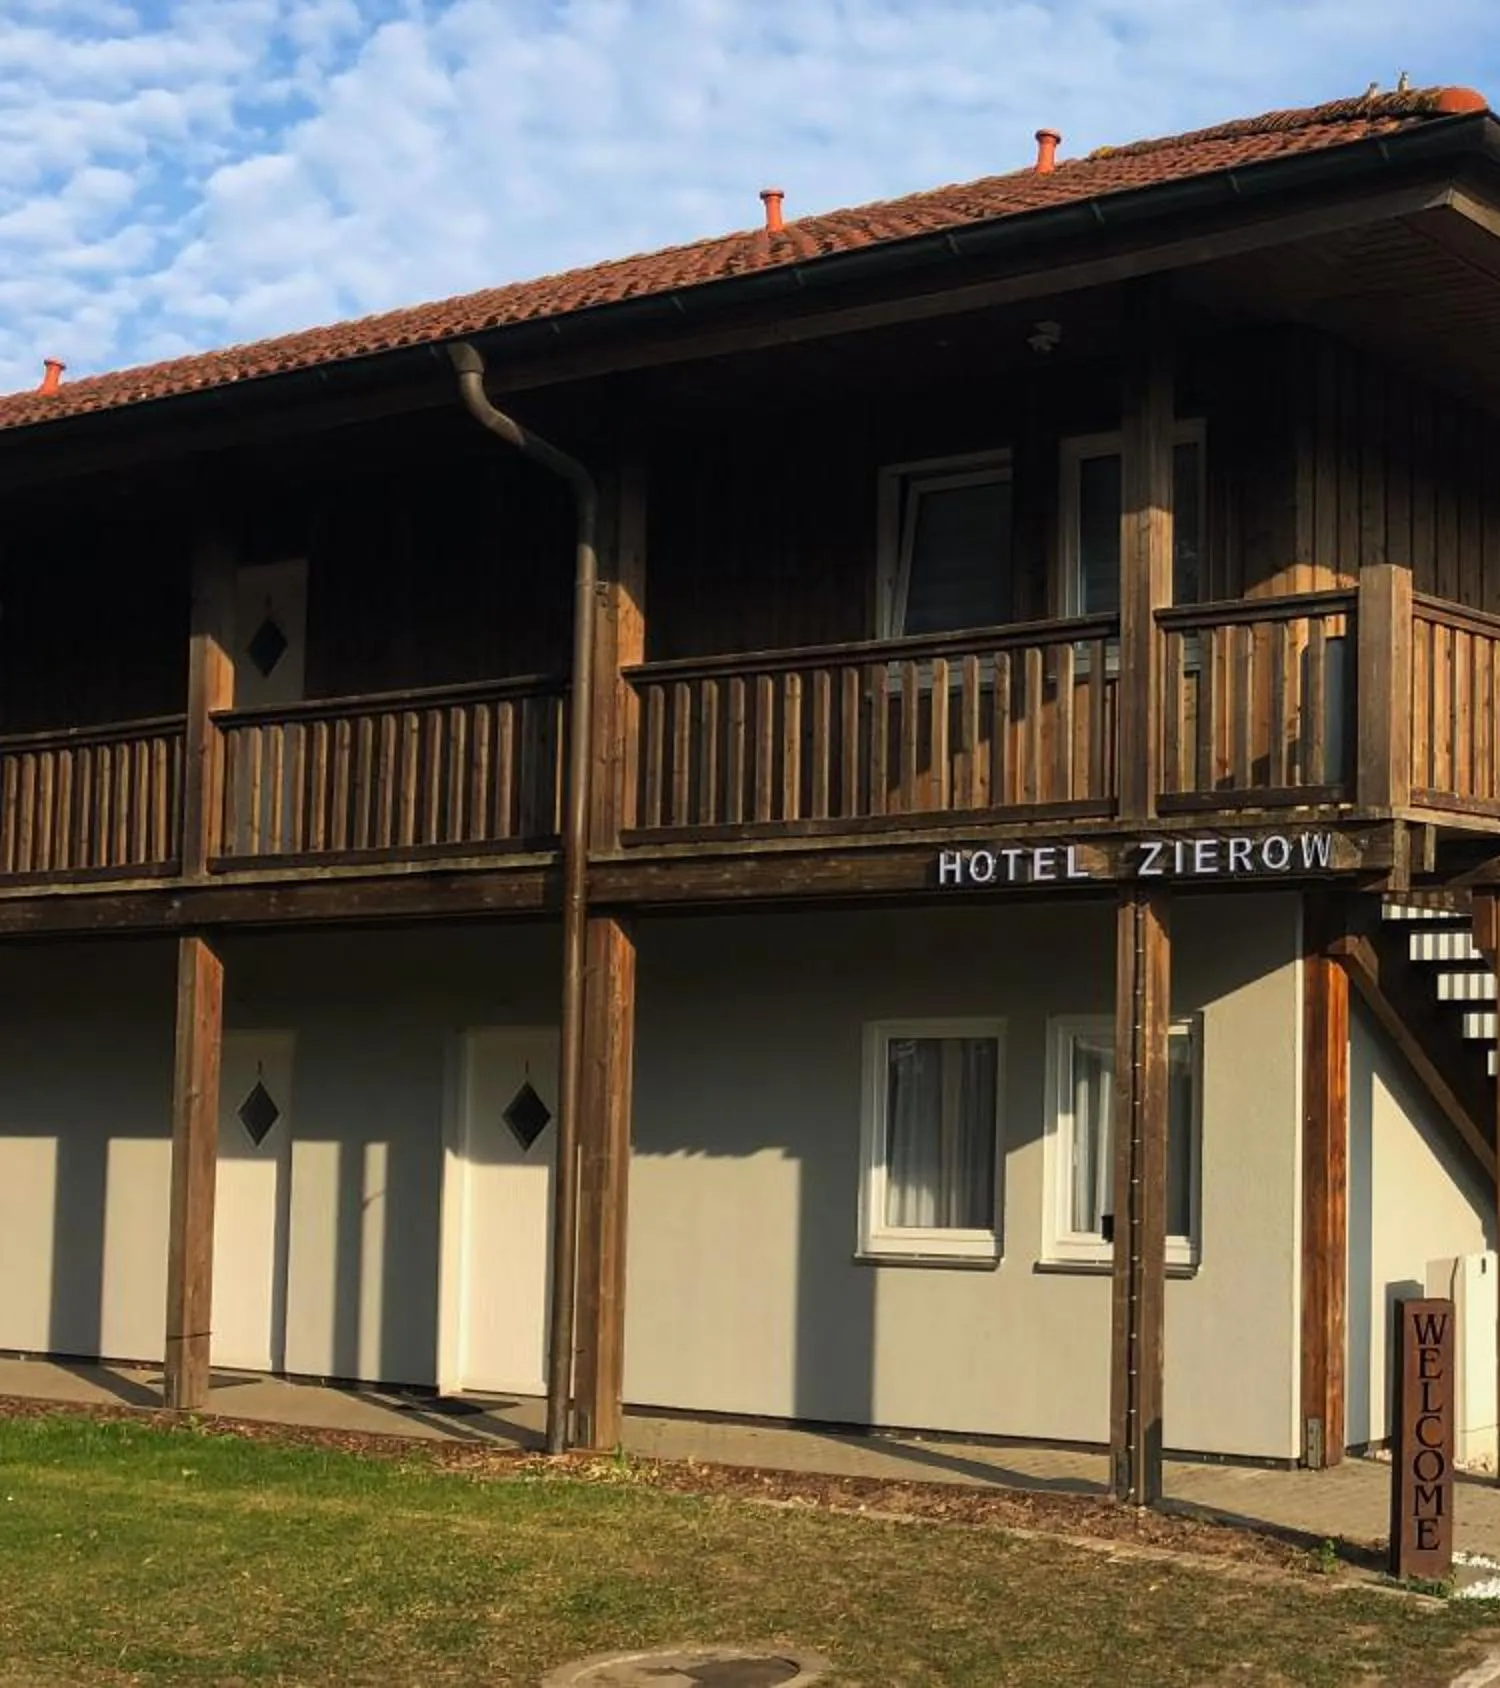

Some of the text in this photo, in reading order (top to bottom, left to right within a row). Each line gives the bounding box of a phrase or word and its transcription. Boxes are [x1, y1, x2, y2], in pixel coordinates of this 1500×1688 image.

[939, 832, 1333, 885] HOTEL ZIEROW
[1412, 1313, 1448, 1551] WELCOME
